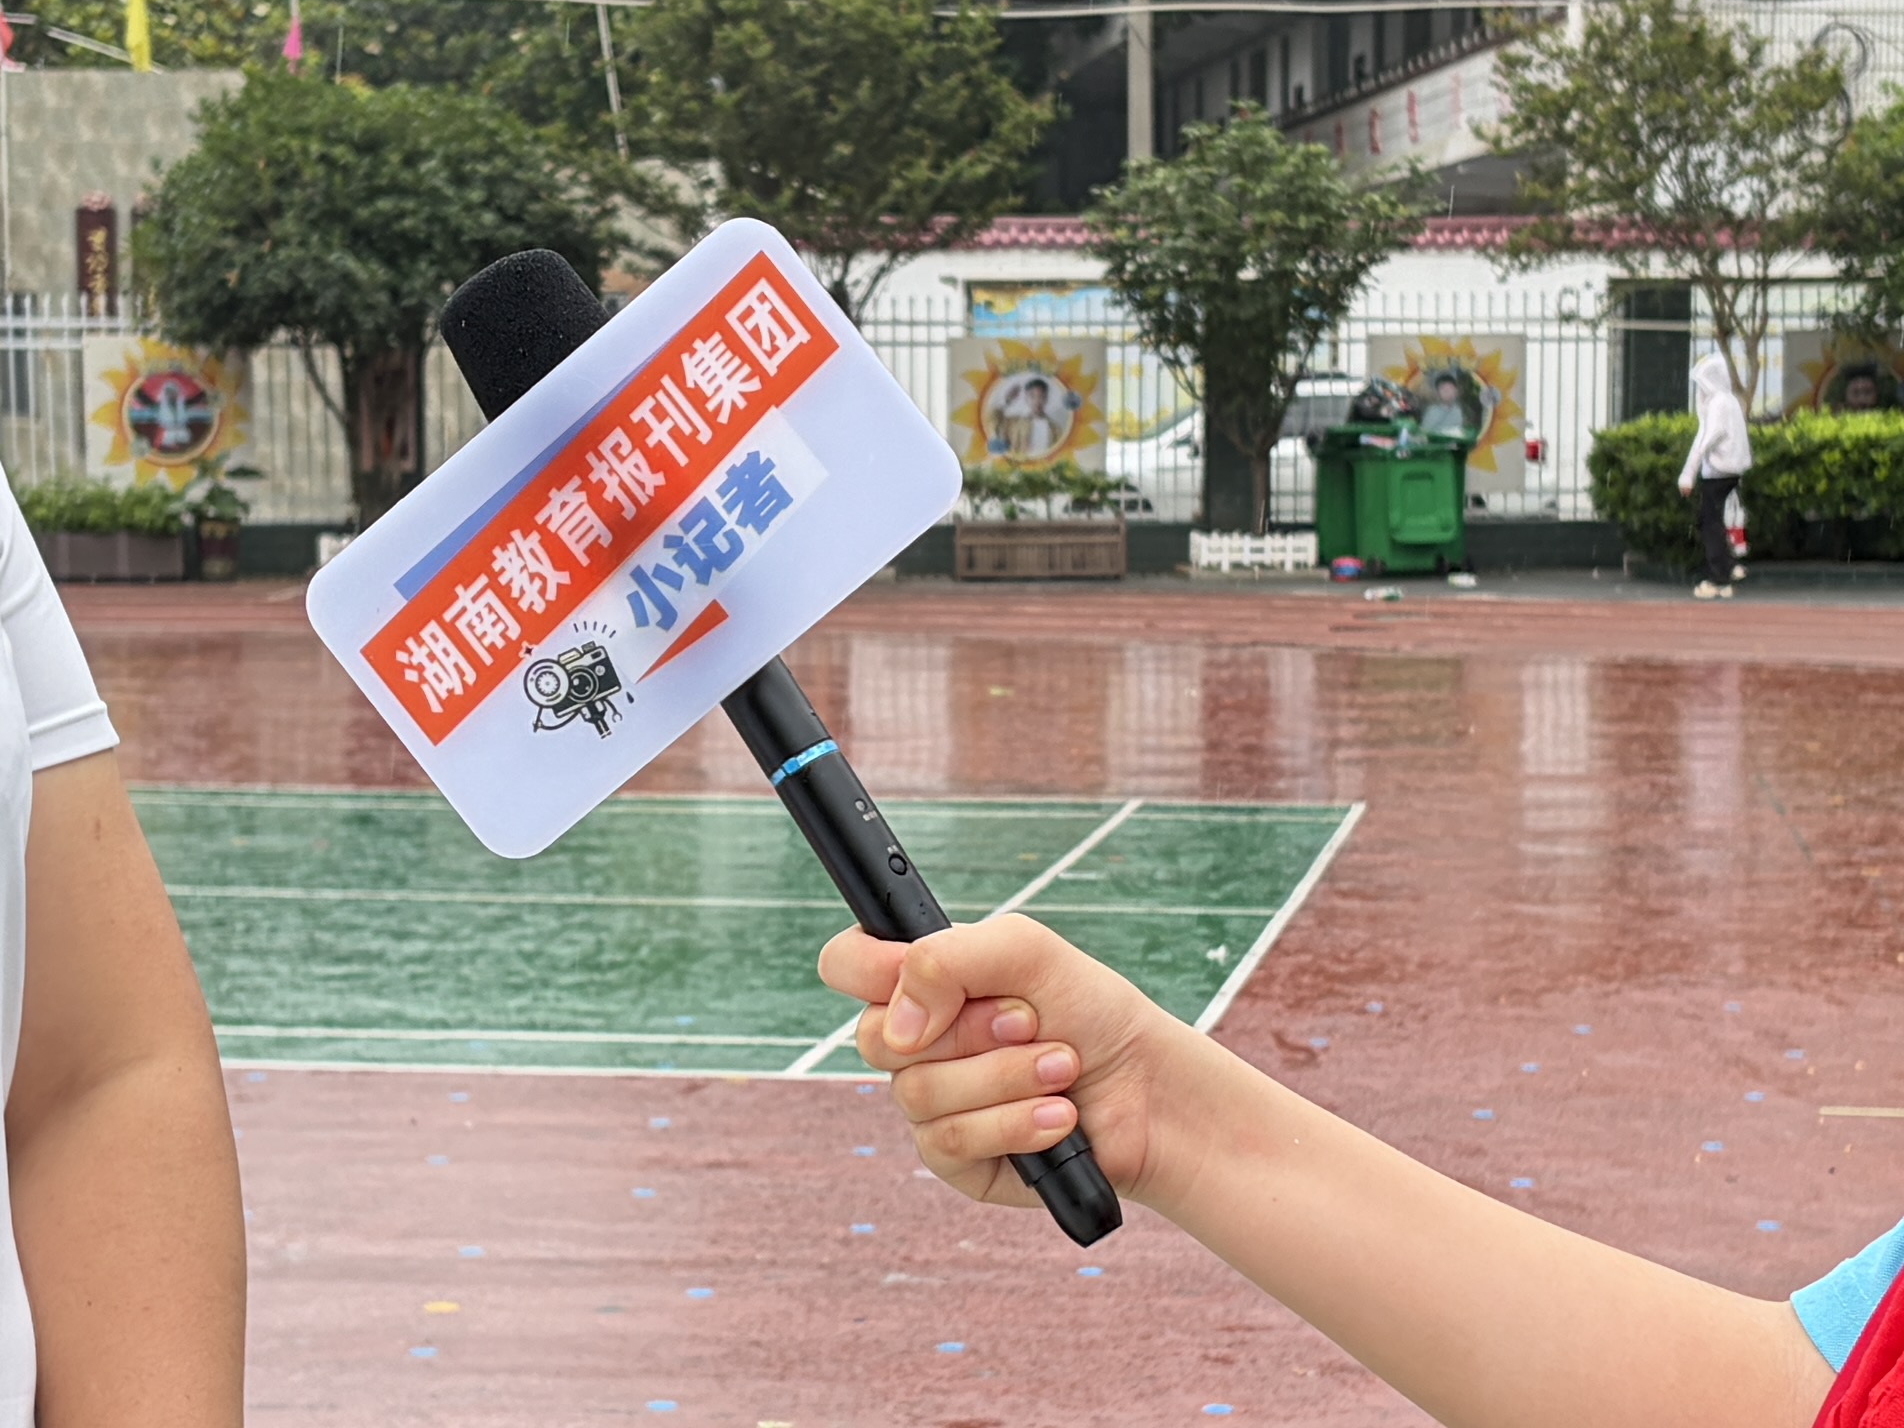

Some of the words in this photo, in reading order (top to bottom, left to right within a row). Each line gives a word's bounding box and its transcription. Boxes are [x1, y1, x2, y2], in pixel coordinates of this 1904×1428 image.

[394, 277, 814, 713] 湖南教育报刊集团
[626, 451, 794, 631] 小记者
